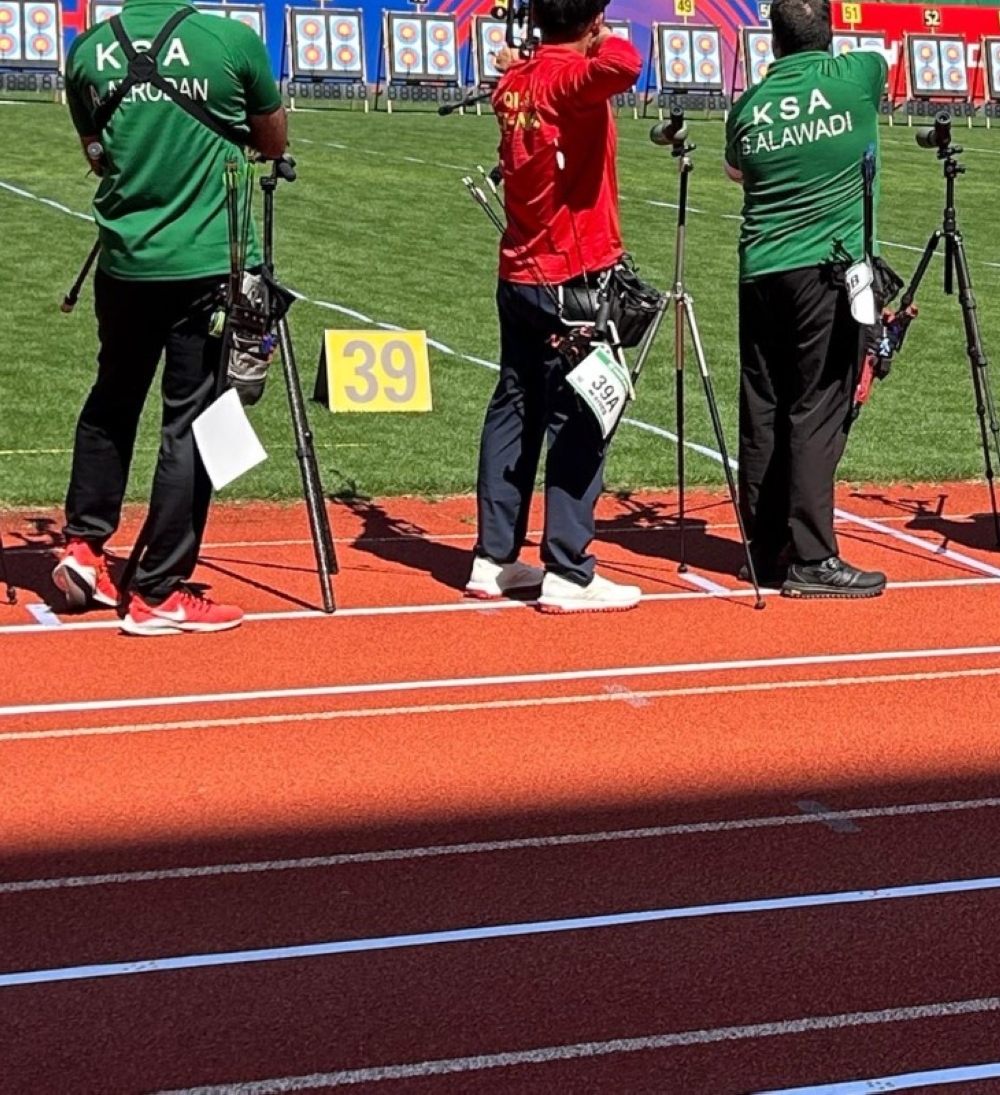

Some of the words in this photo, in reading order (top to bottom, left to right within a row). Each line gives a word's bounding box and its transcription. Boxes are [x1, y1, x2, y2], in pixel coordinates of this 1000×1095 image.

[677, 0, 693, 13] 49
[844, 6, 859, 19] 51
[924, 9, 940, 26] 52
[343, 340, 416, 403] 39
